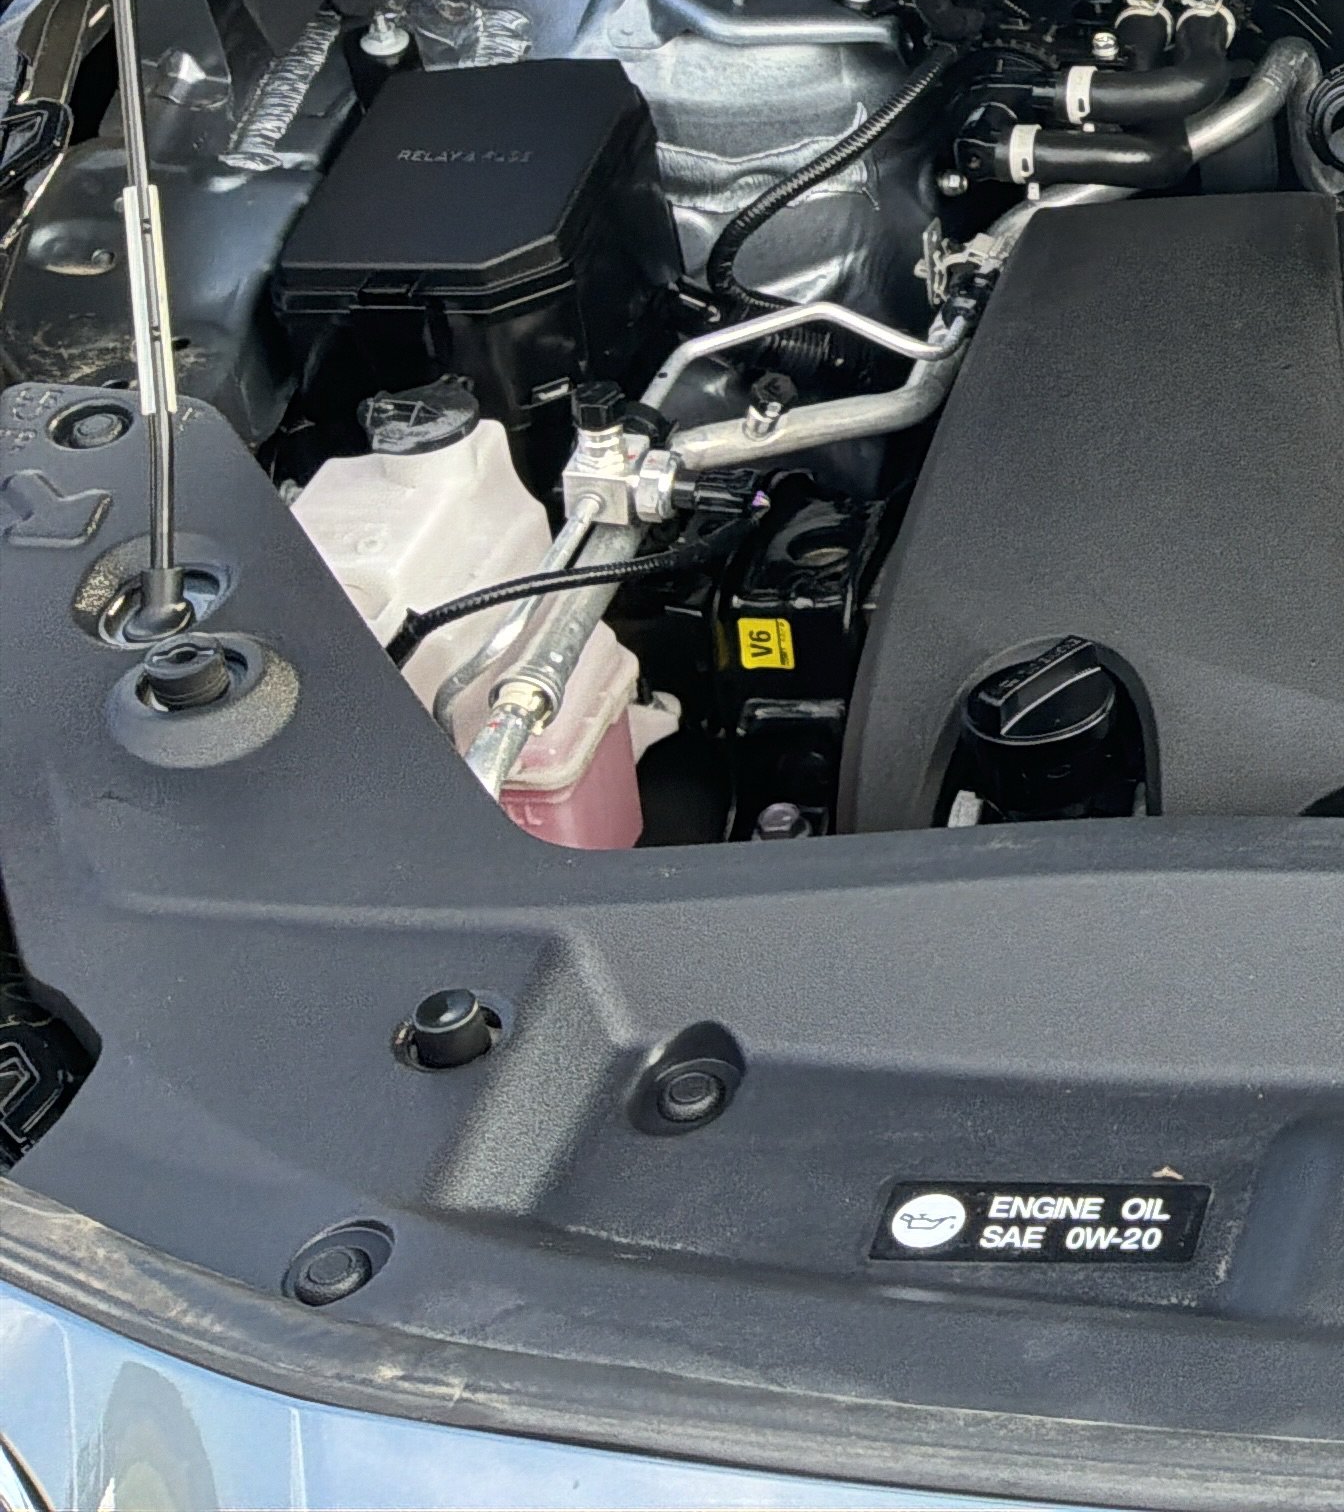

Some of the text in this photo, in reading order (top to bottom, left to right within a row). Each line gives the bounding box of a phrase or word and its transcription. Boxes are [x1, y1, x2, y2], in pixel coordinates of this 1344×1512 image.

[396, 148, 461, 162] RELAY
[748, 629, 774, 659] V6
[988, 1196, 1171, 1222] ENGINE OIL
[979, 1225, 1163, 1251] SAE 0W-20
